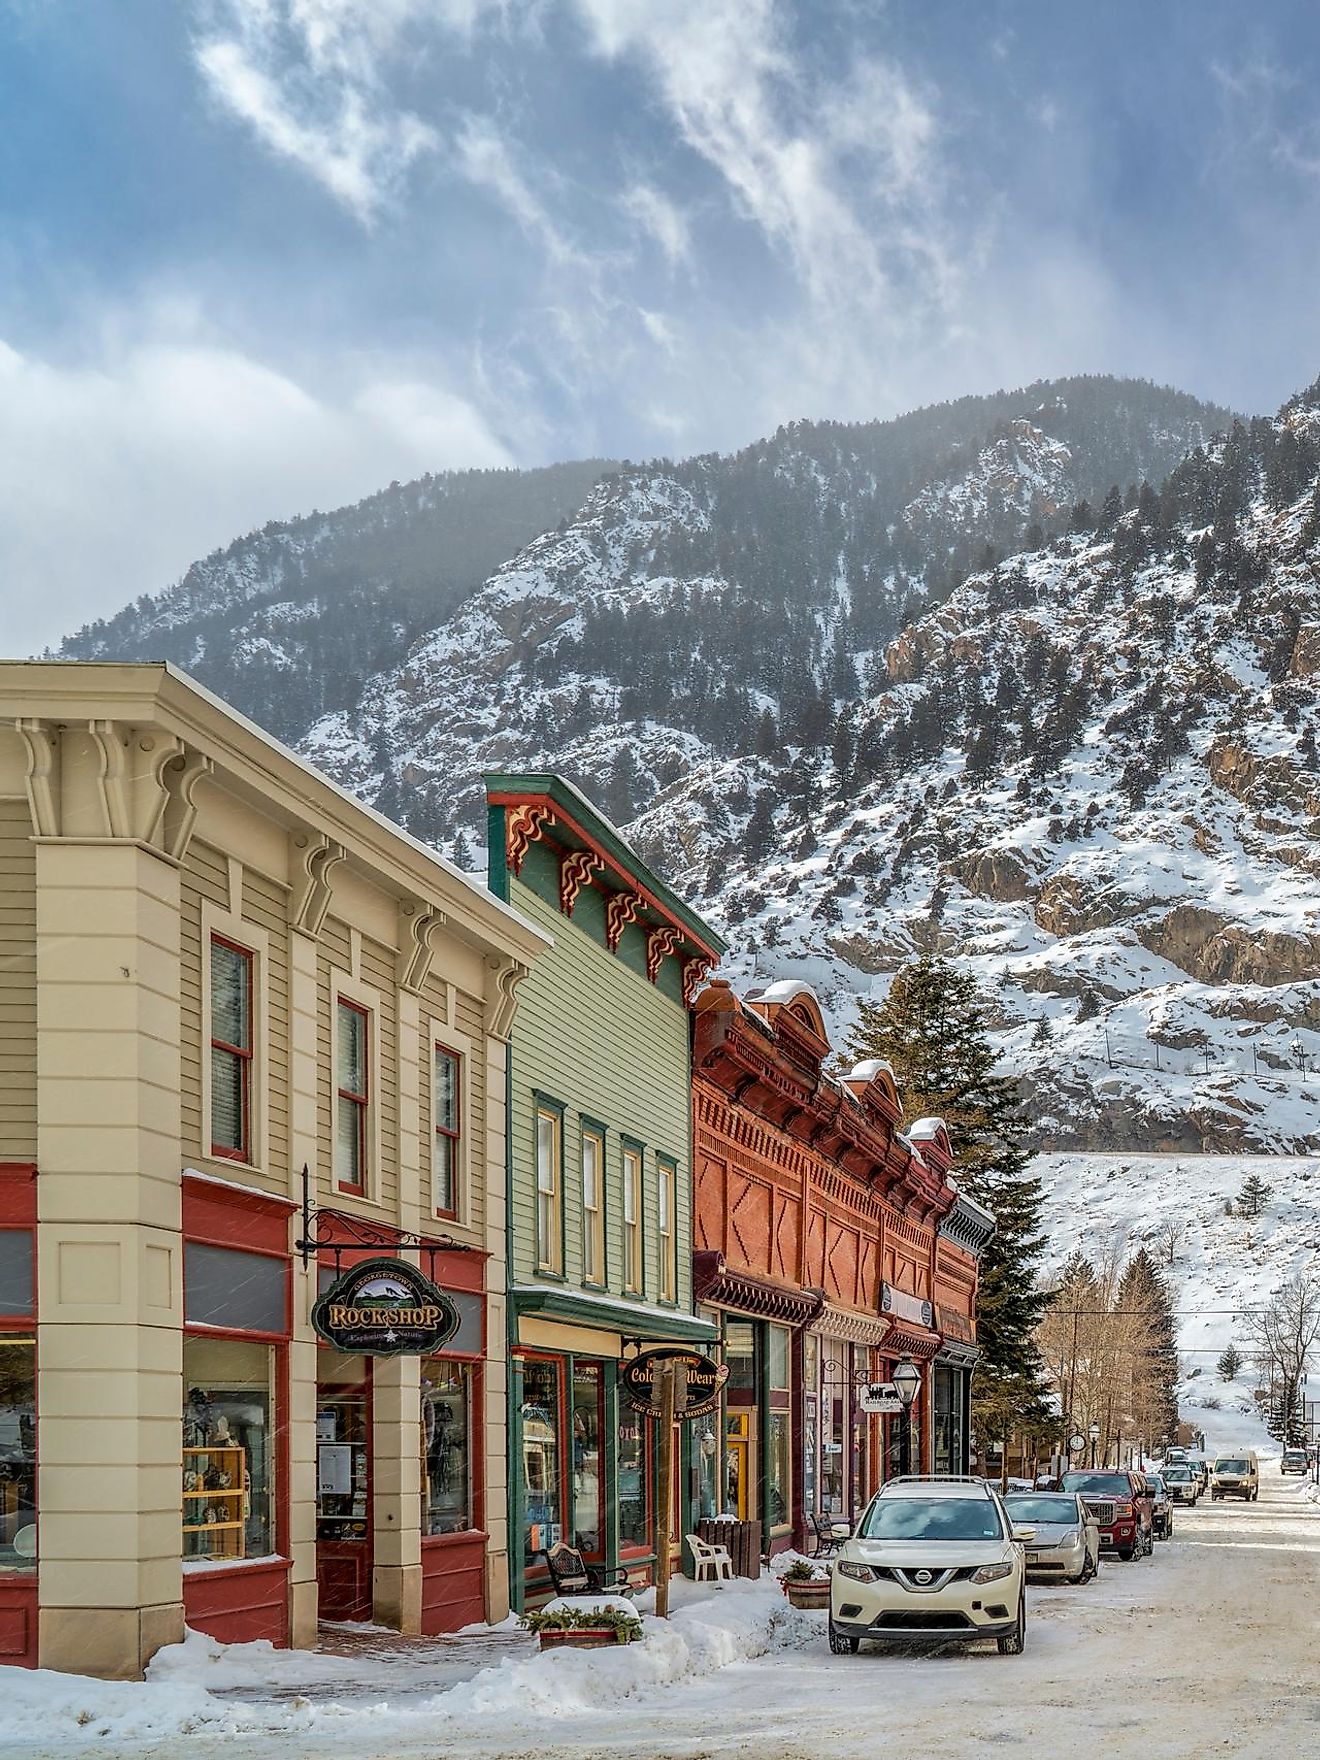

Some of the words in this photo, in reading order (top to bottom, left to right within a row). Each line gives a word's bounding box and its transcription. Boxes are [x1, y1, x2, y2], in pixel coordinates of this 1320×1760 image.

[354, 1270, 414, 1292] GEORGETOWN
[329, 1305, 384, 1329] ROCK
[383, 1305, 443, 1330] SHOP
[686, 1369, 713, 1385] Wear
[631, 1402, 645, 1412] ICE
